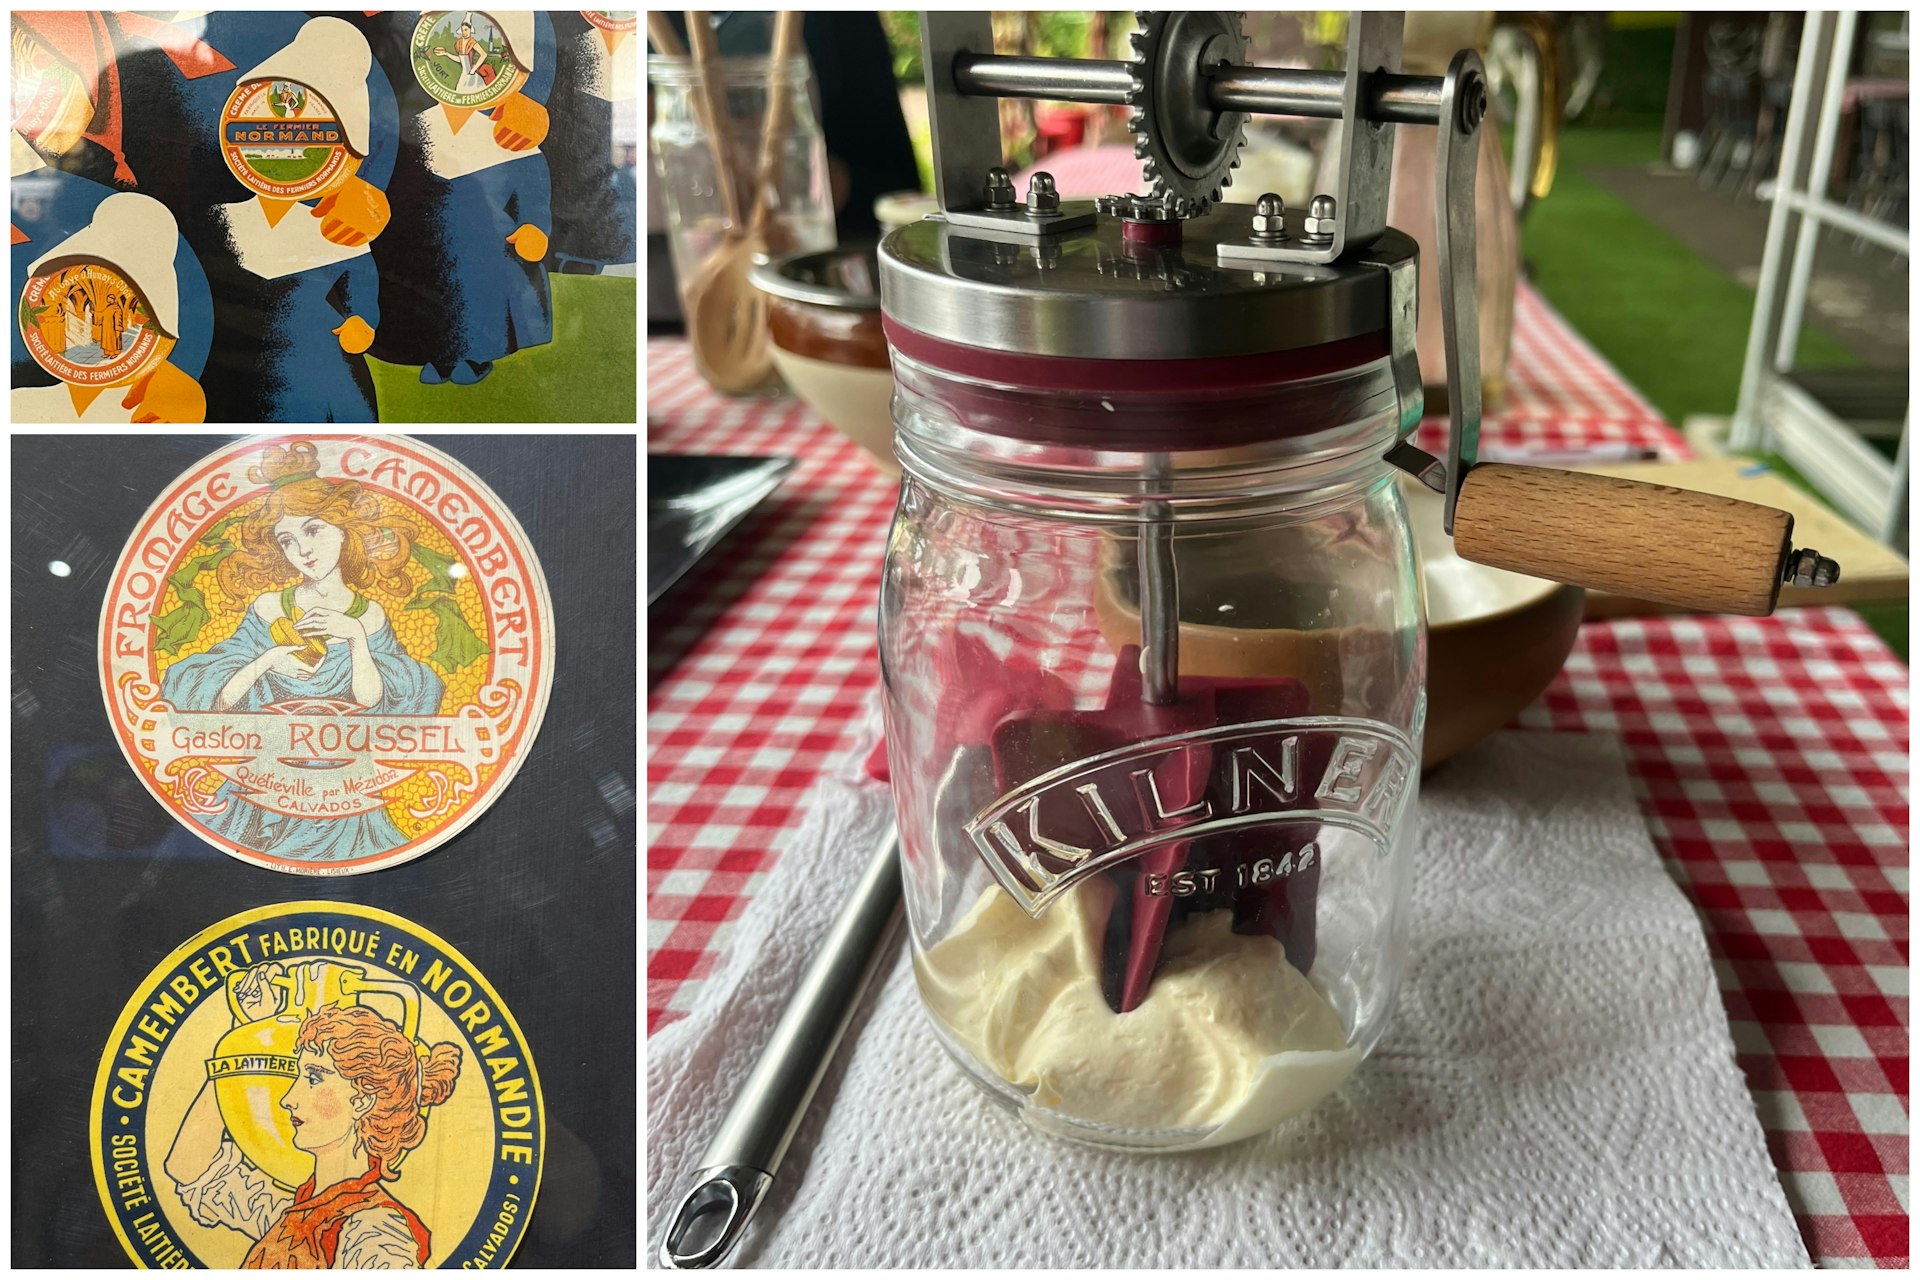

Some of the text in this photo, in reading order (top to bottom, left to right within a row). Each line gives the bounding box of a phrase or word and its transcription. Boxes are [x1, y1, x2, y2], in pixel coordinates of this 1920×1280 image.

[433, 62, 449, 80] JORT
[235, 131, 339, 141] NORMAND
[272, 186, 284, 194] DES
[286, 180, 317, 194] FERMIERS
[316, 151, 342, 183] NORMANDS
[73, 370, 88, 380] DES
[90, 362, 128, 380] FERMIERS
[126, 332, 153, 367] NORMANDS
[115, 448, 527, 668] FROMAGE CAMEMBERT
[171, 723, 466, 757] Gaston ROUSSEL
[322, 789, 340, 801] par
[342, 769, 400, 795] Mézidon
[987, 735, 1408, 894] KILNER
[1144, 841, 1317, 897] EST 1842
[112, 926, 534, 1167] CAMEMBERT FABRIQUÉ EN NORMANDIE
[211, 1056, 296, 1074] LA LAITIÈRE
[111, 1134, 152, 1211] SOCIÉTÉ
